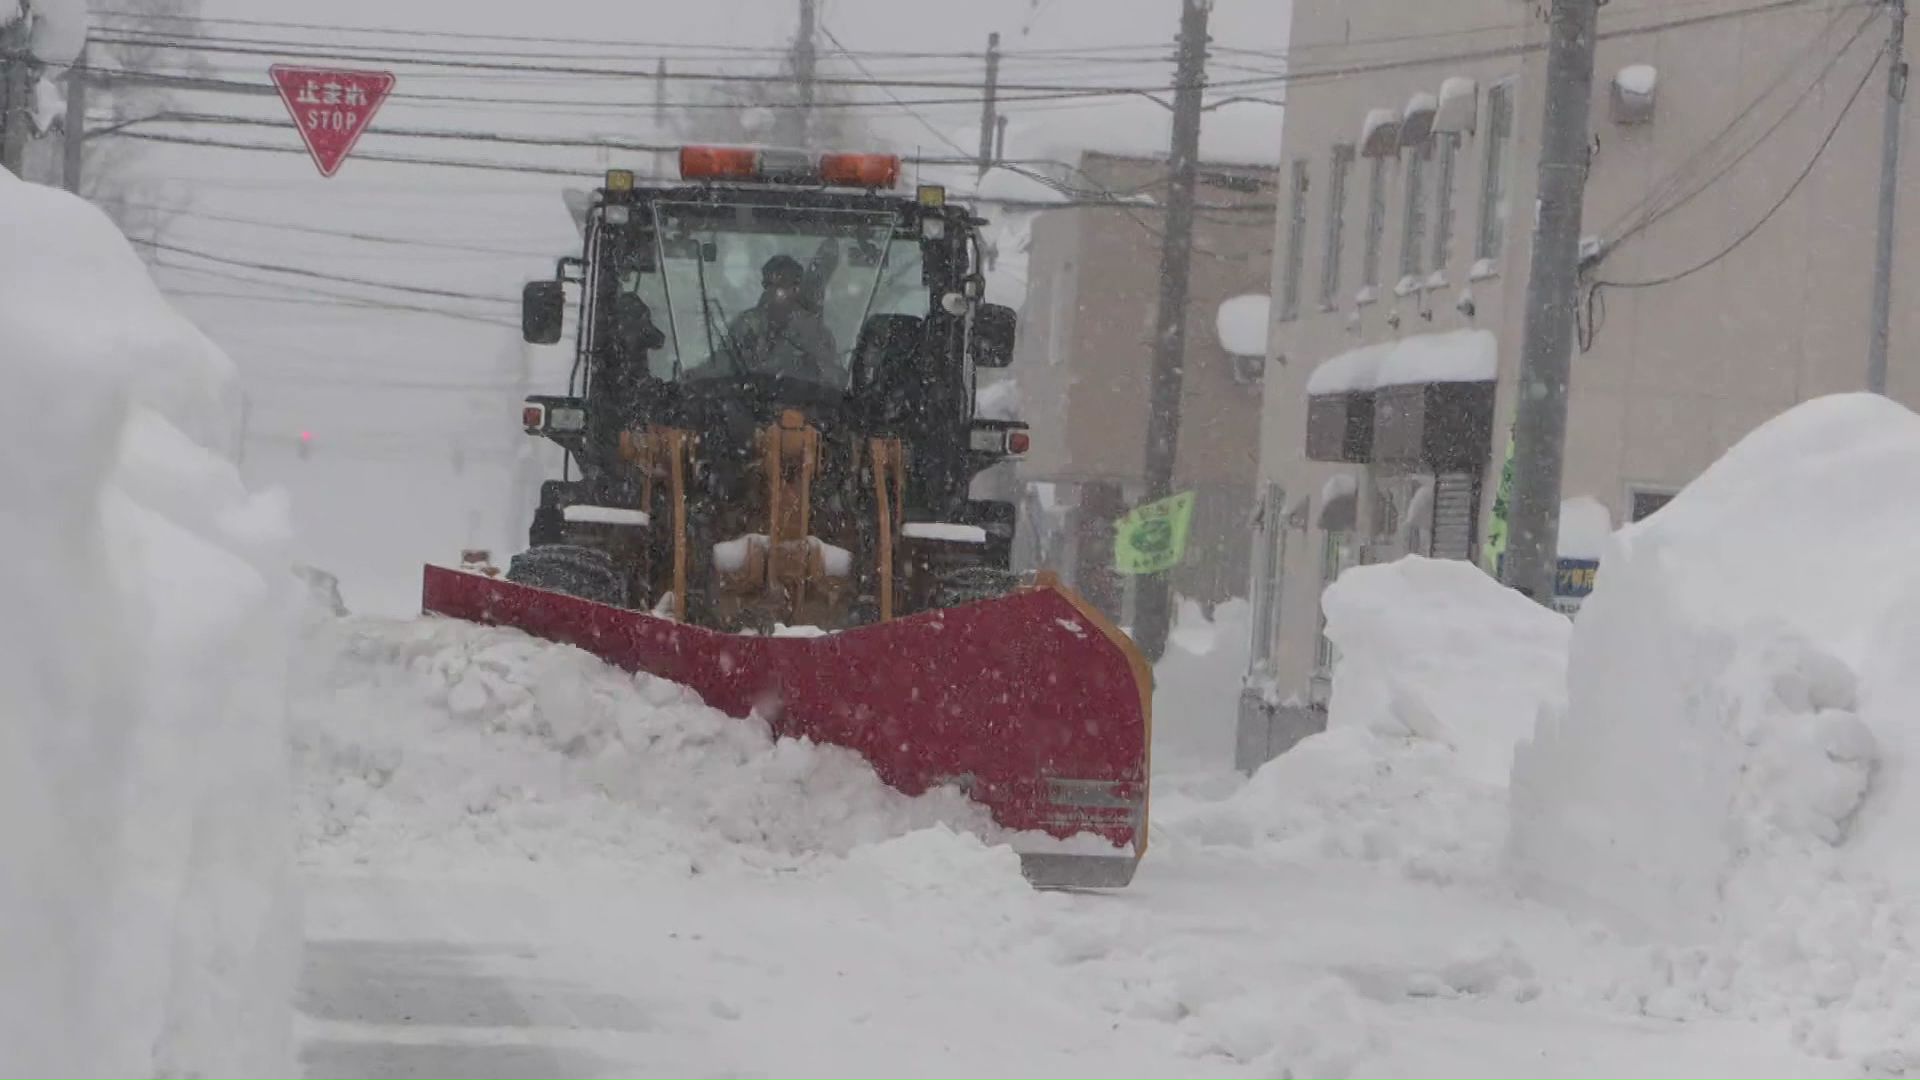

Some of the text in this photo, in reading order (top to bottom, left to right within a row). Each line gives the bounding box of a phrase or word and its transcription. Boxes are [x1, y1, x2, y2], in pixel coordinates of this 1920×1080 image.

[296, 80, 368, 105] 止まれ
[308, 110, 357, 130] STOP
